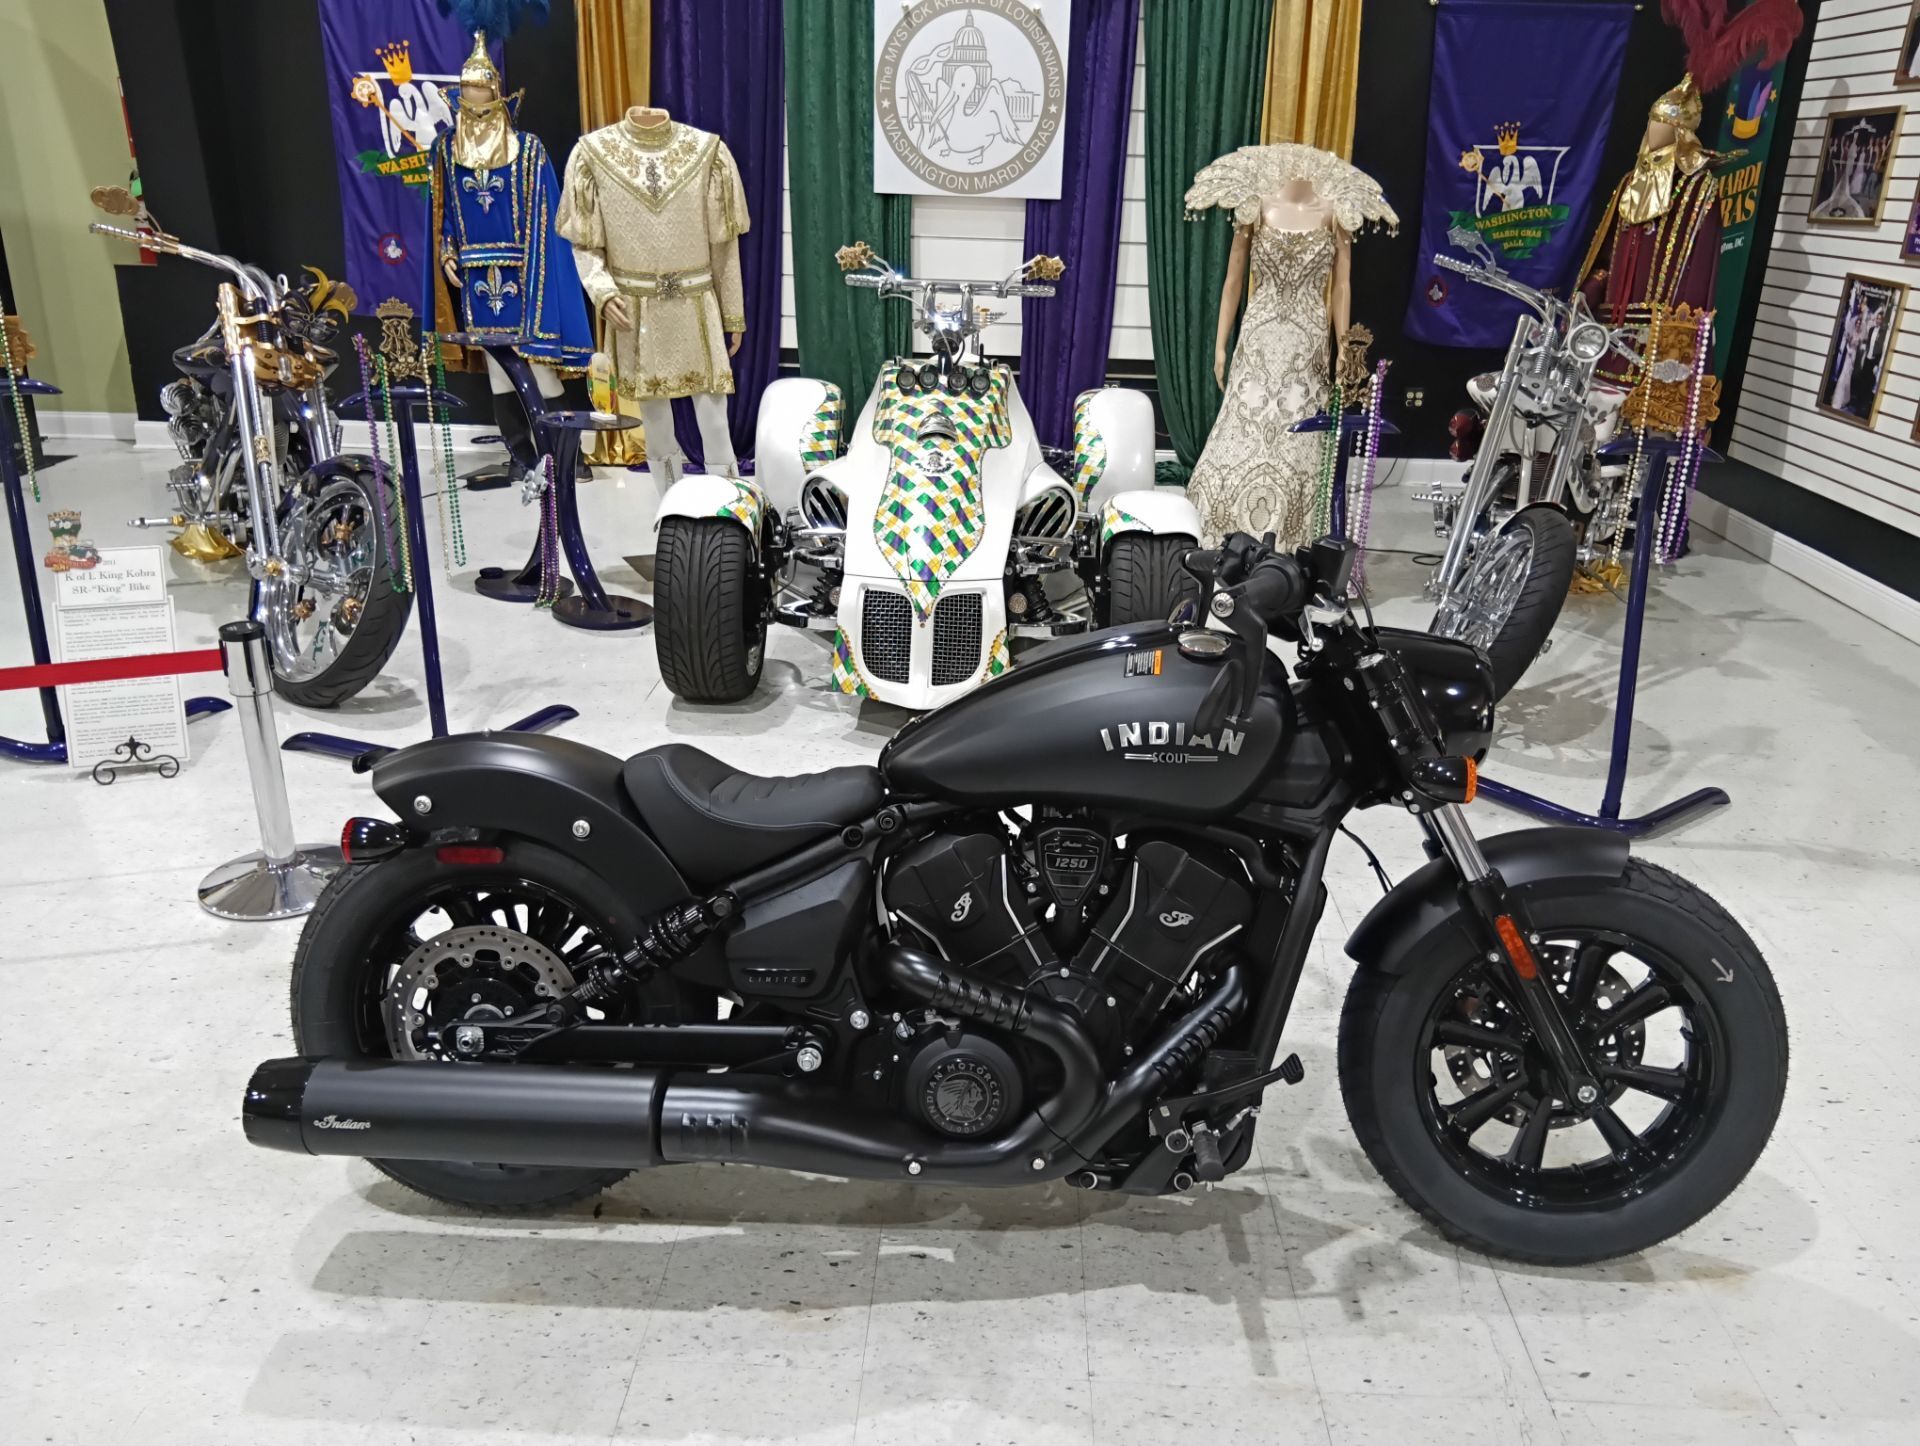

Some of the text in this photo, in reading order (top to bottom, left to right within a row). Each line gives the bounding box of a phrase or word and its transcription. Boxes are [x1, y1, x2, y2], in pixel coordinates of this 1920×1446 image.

[885, 3, 933, 63] MYSTICK
[1005, 5, 1060, 98] LOUISIANIANS
[880, 65, 893, 93] The
[884, 114, 1055, 190] WASHINGTON MARDI GRAS
[377, 153, 430, 175] WASHI
[1475, 207, 1552, 230] WASHINGTON
[1720, 189, 1758, 228] RAS
[1492, 229, 1542, 239] MARDI GRAS
[1503, 240, 1524, 250] BALL
[65, 573, 74, 582] K
[76, 571, 86, 580] of
[100, 570, 124, 581] King
[126, 569, 156, 578] Kobra
[129, 582, 151, 592] Bike
[1151, 751, 1190, 764] SCOUT
[1055, 857, 1088, 869] 1250
[926, 1062, 1000, 1121] INDIAN MOTORCYCLE
[313, 1114, 372, 1130] Indian
